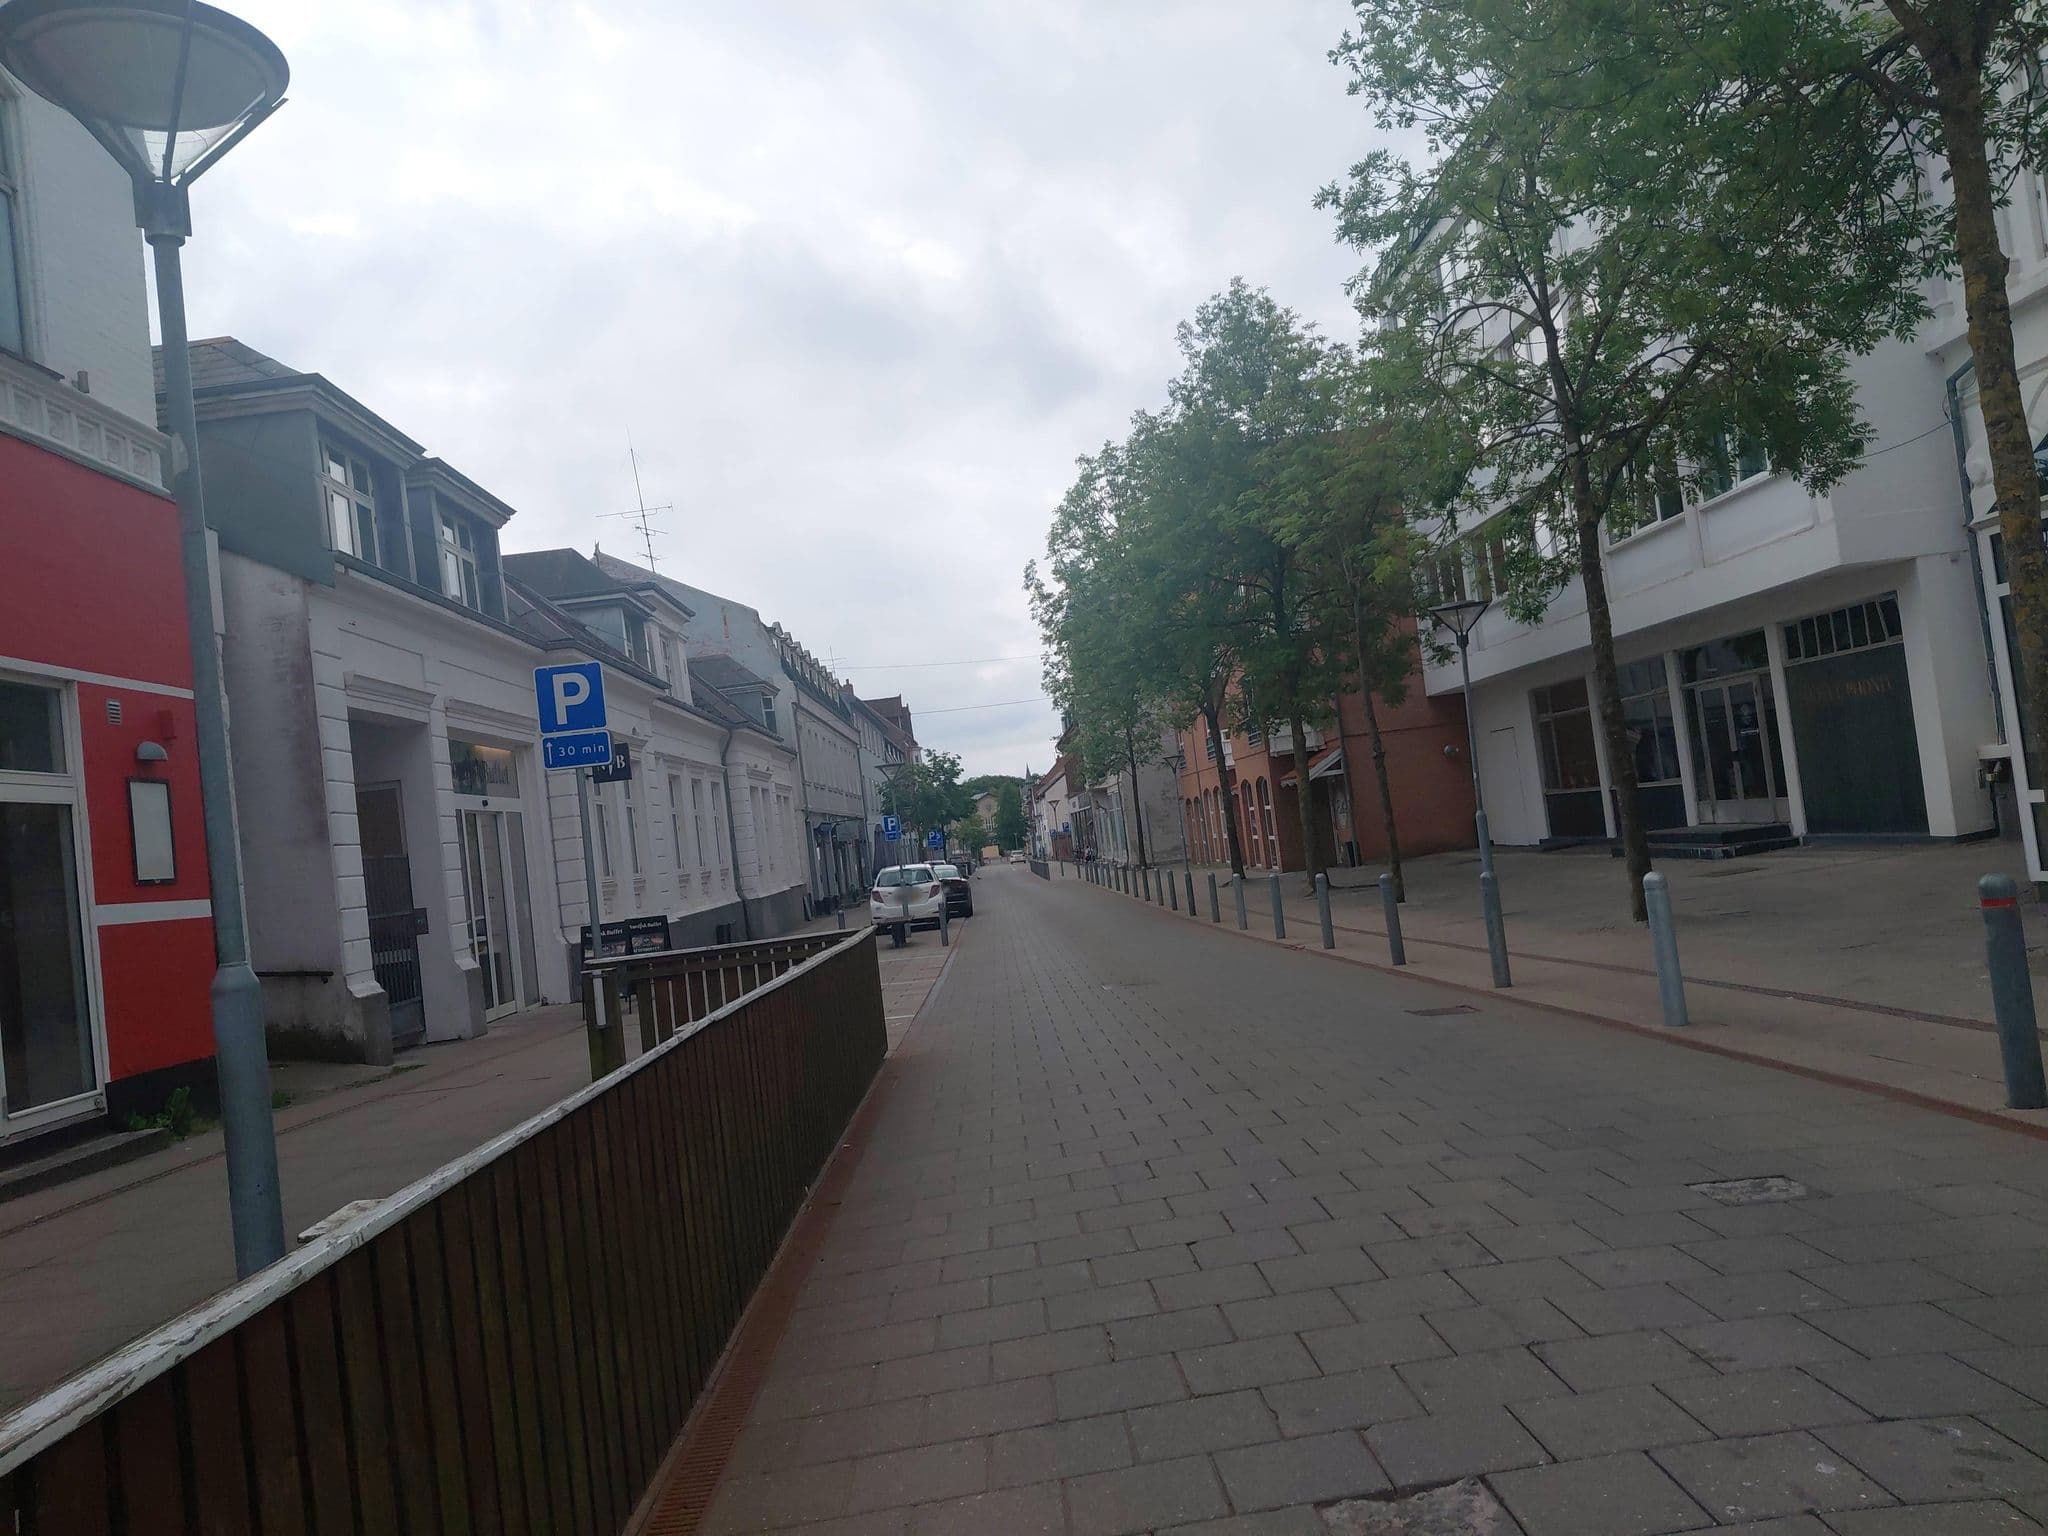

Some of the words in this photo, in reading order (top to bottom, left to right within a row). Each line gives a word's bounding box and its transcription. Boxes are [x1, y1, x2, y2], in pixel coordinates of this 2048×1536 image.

[552, 673, 590, 725] P
[558, 745, 576, 757] 30
[582, 743, 605, 754] min
[888, 818, 895, 830] P
[929, 831, 935, 840] P
